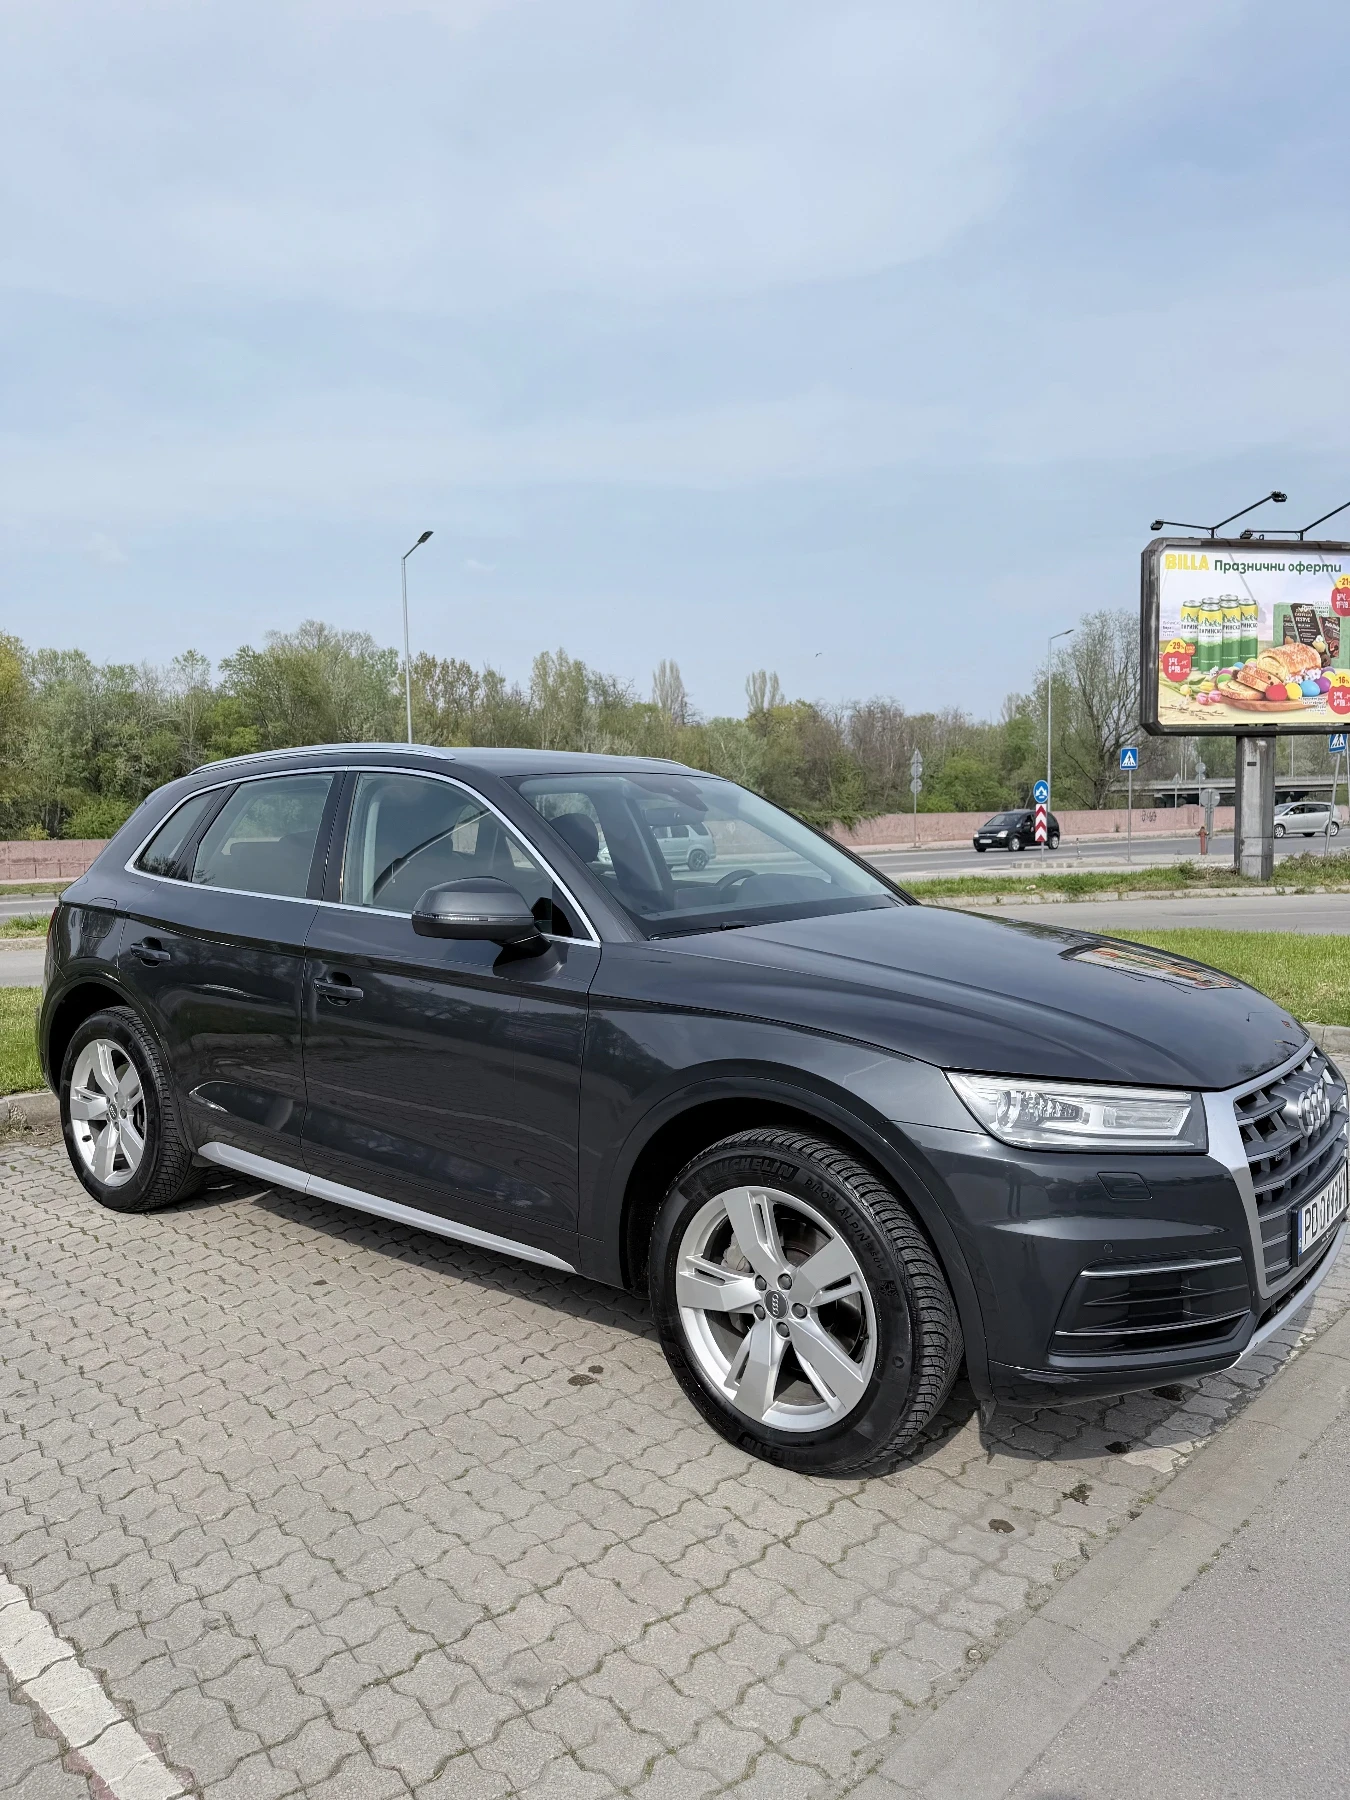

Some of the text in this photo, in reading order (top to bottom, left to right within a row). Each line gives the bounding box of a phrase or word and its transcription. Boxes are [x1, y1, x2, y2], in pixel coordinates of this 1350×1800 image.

[1165, 553, 1209, 570] BILLA
[1214, 559, 1342, 575] Празнични оферти
[708, 1156, 796, 1179] MICHELIN
[804, 1178, 837, 1205] PILOT
[838, 1207, 870, 1242] ALPIN
